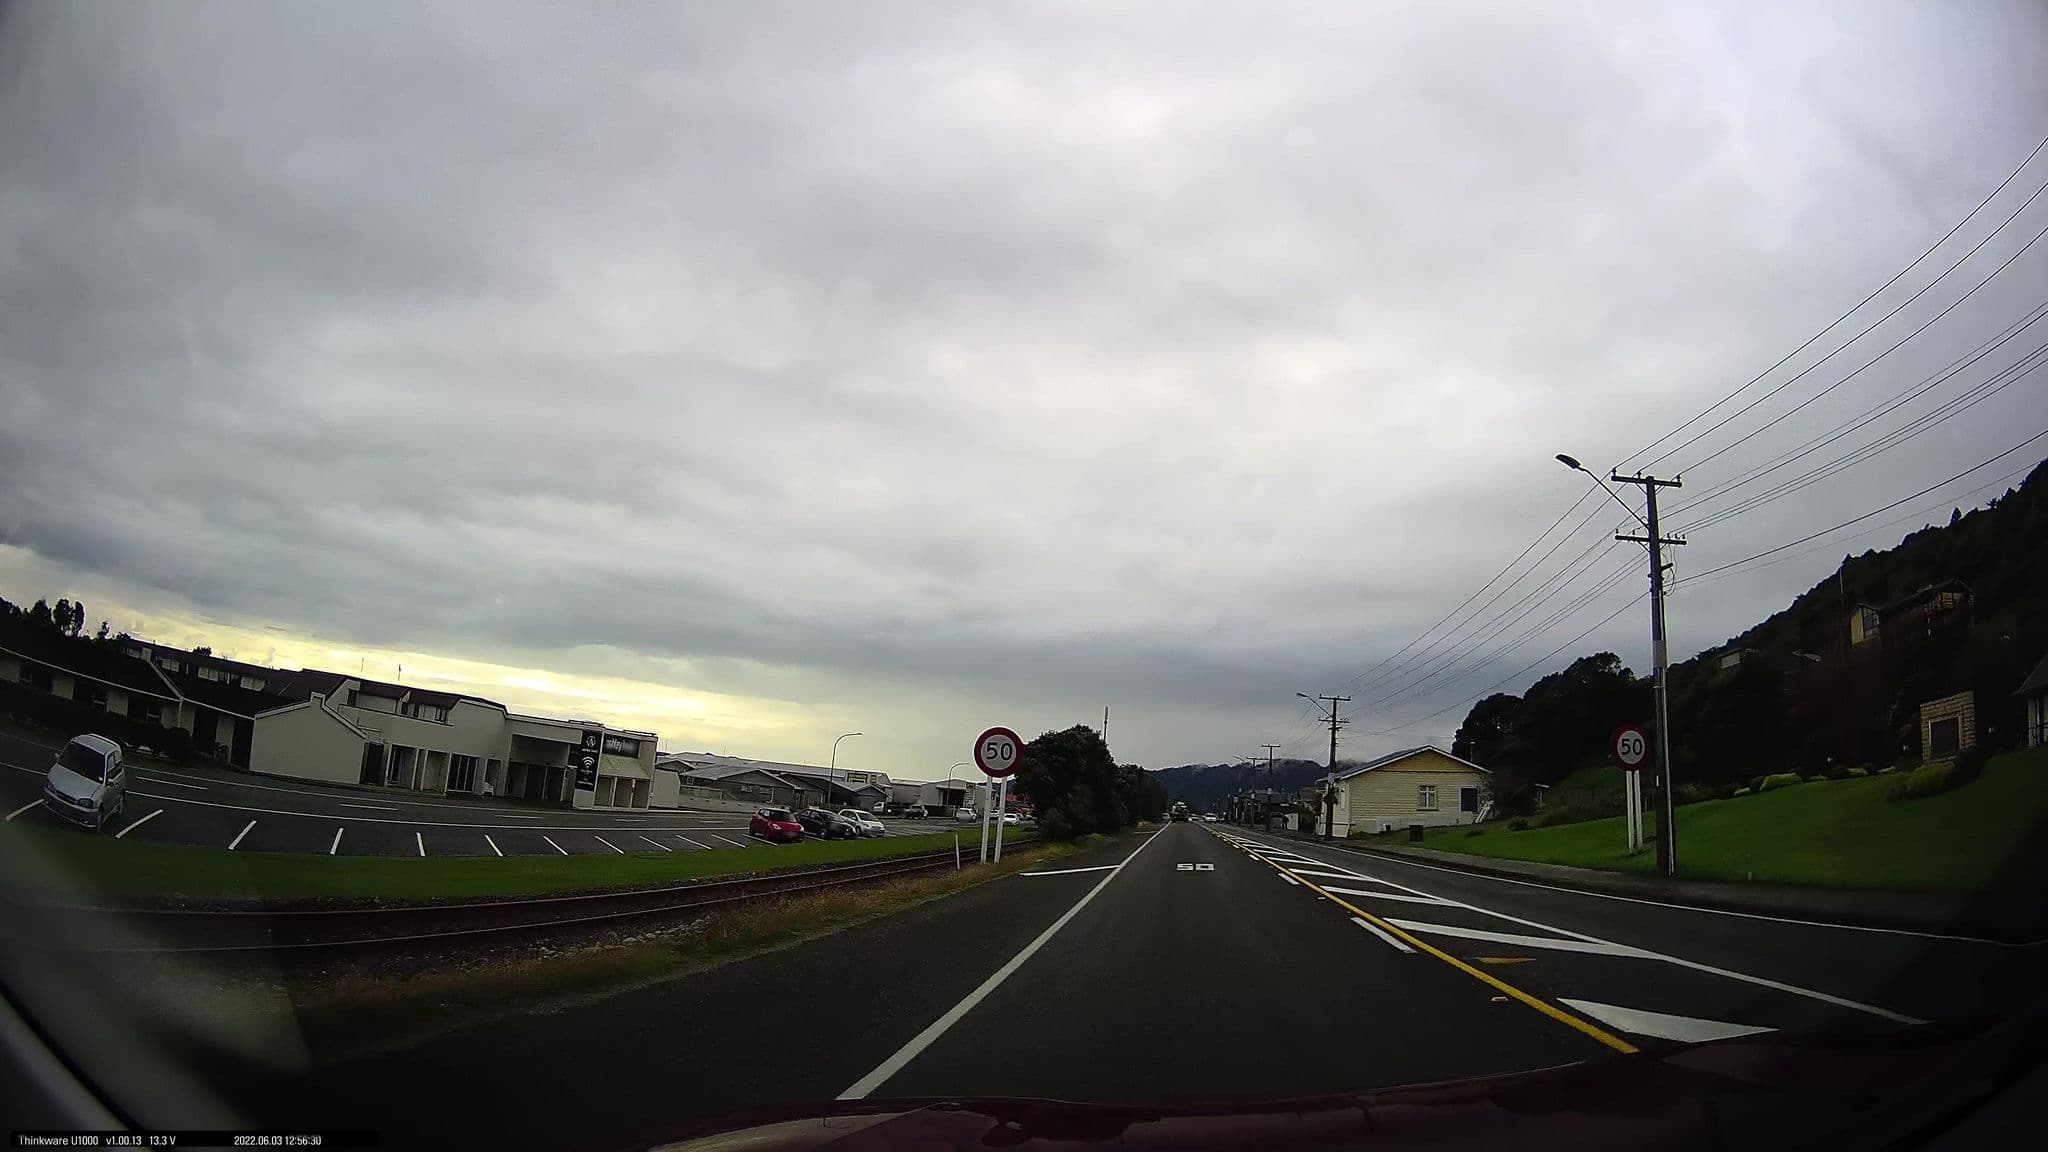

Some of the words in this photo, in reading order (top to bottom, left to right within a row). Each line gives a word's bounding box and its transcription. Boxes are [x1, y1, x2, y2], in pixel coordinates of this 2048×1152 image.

[986, 742, 1013, 761] 50
[1621, 738, 1643, 756] 50
[1176, 863, 1215, 871] 50
